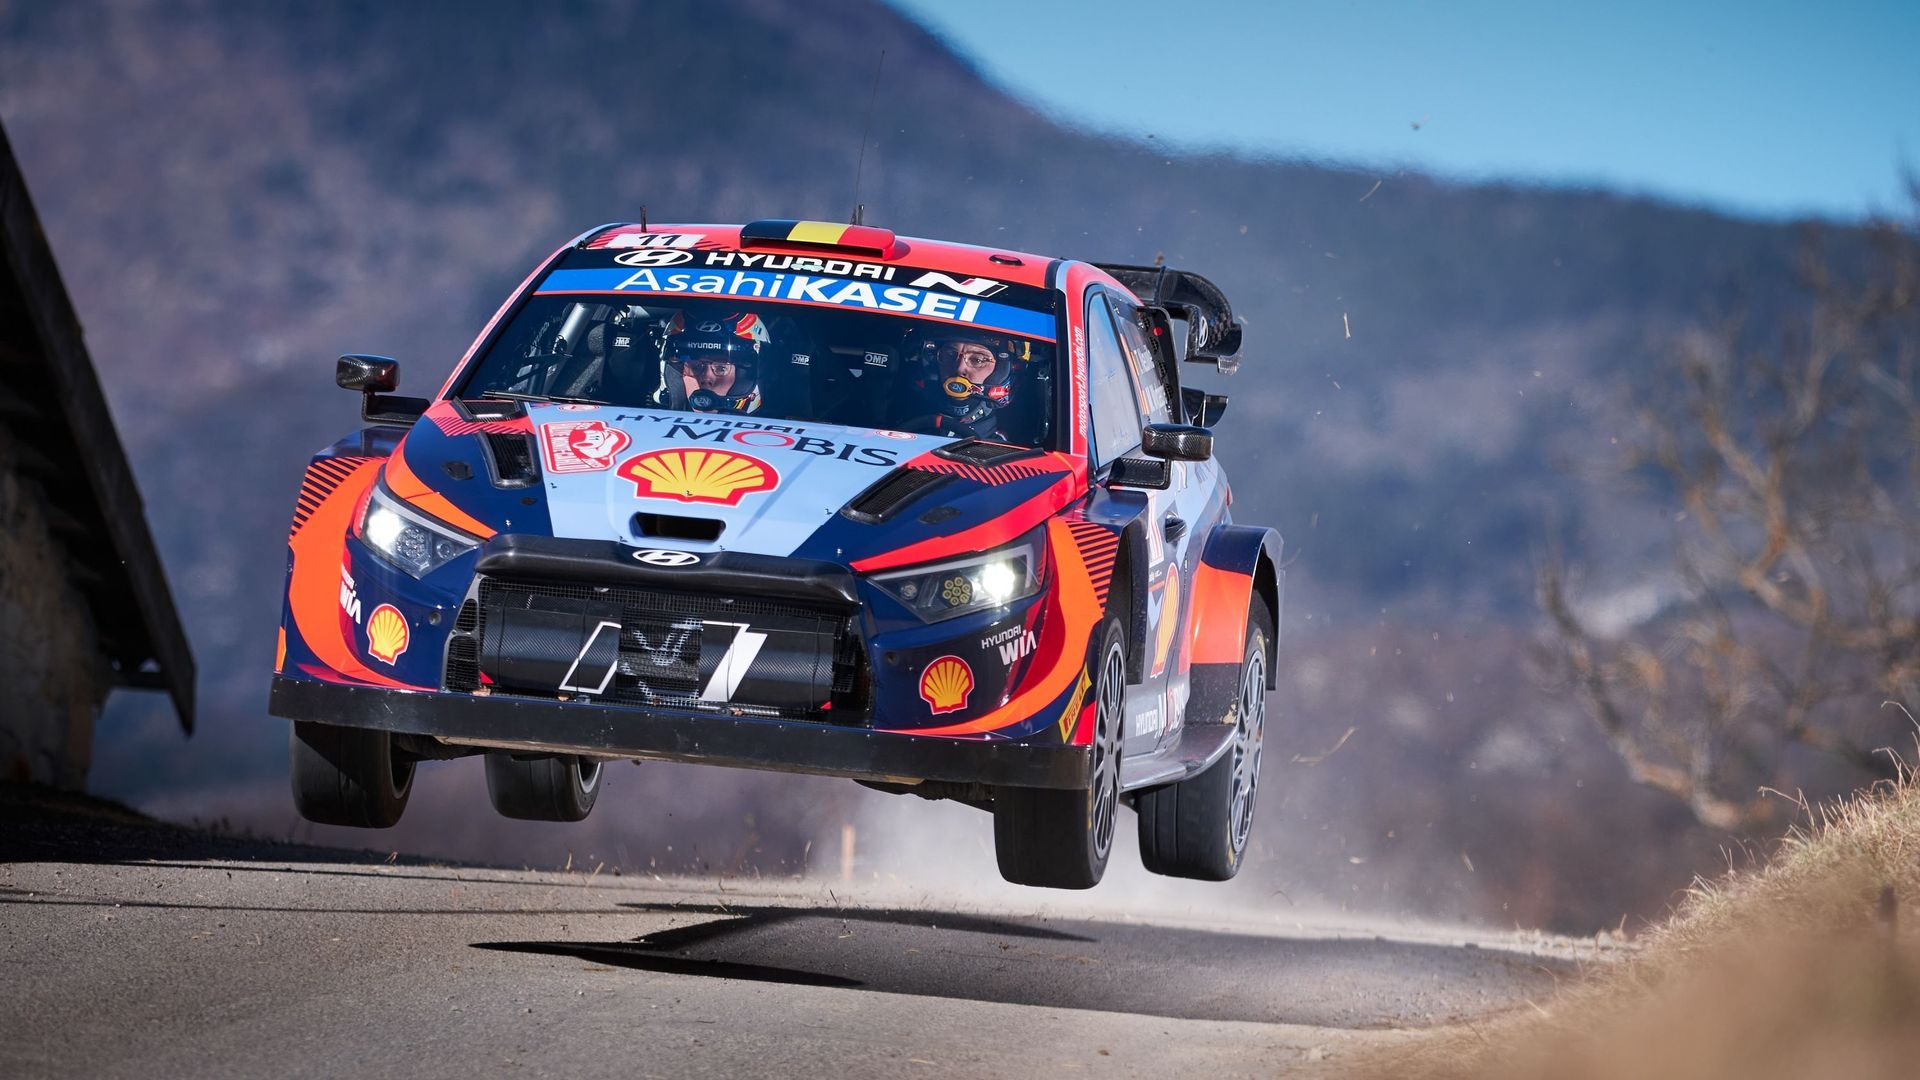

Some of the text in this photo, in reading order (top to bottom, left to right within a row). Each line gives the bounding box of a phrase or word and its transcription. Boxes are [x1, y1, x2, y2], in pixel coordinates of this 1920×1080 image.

[638, 234, 672, 246] 11
[705, 251, 895, 281] HYUNDAI
[687, 341, 721, 350] HYUNDAI
[791, 354, 810, 365] OMP
[864, 353, 888, 366] OMP
[1073, 325, 1088, 440] motorsport.hyundai.com
[615, 414, 806, 434] HYUNDAI
[661, 424, 898, 468] MOBIS
[981, 624, 1022, 650] HYUNDAI
